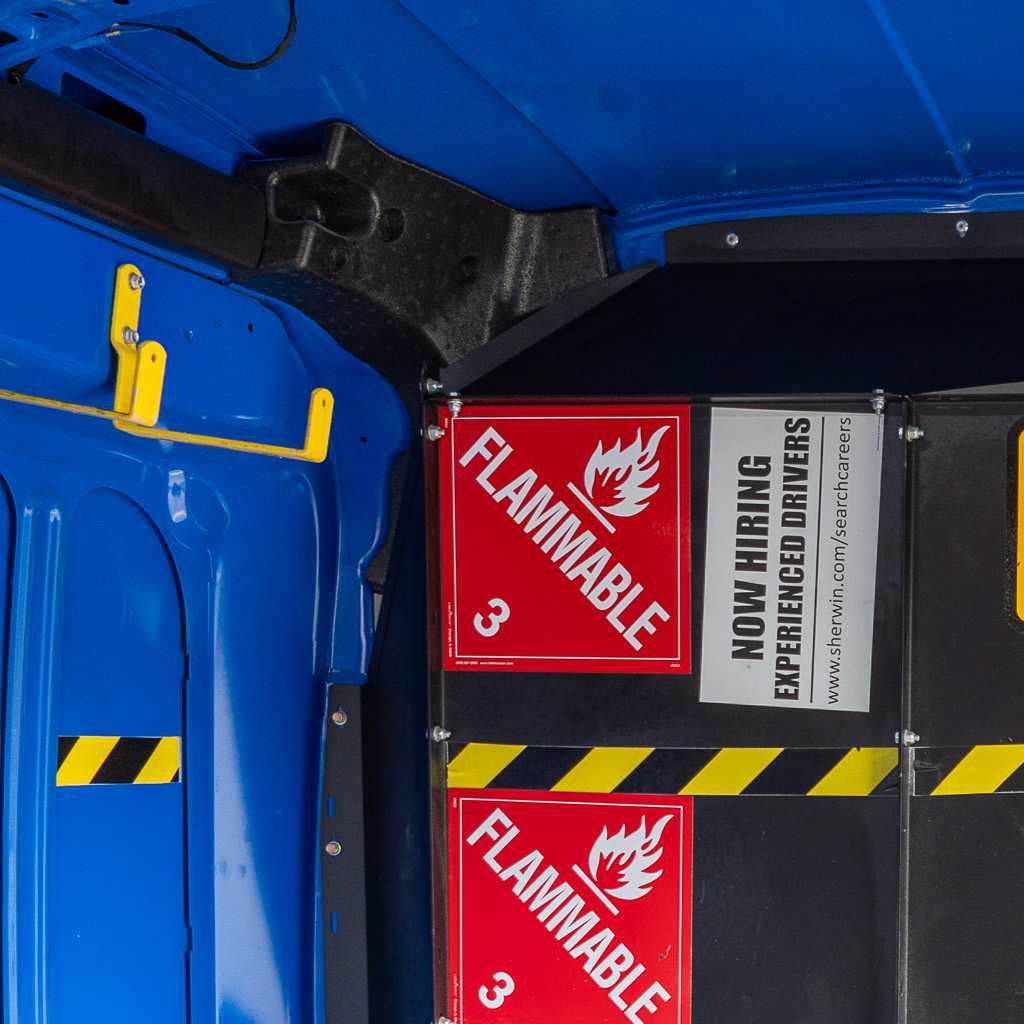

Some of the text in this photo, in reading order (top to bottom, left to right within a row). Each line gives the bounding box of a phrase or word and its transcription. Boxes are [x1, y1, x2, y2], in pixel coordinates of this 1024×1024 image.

[459, 426, 671, 651] FLAMMABLE
[472, 597, 511, 638] 3
[731, 455, 773, 661] NOW HIRING
[773, 416, 811, 700] EXPERIENCED DRIVERS
[827, 416, 852, 705] www.sherwin.com/searchcareers
[478, 971, 515, 1009] 3
